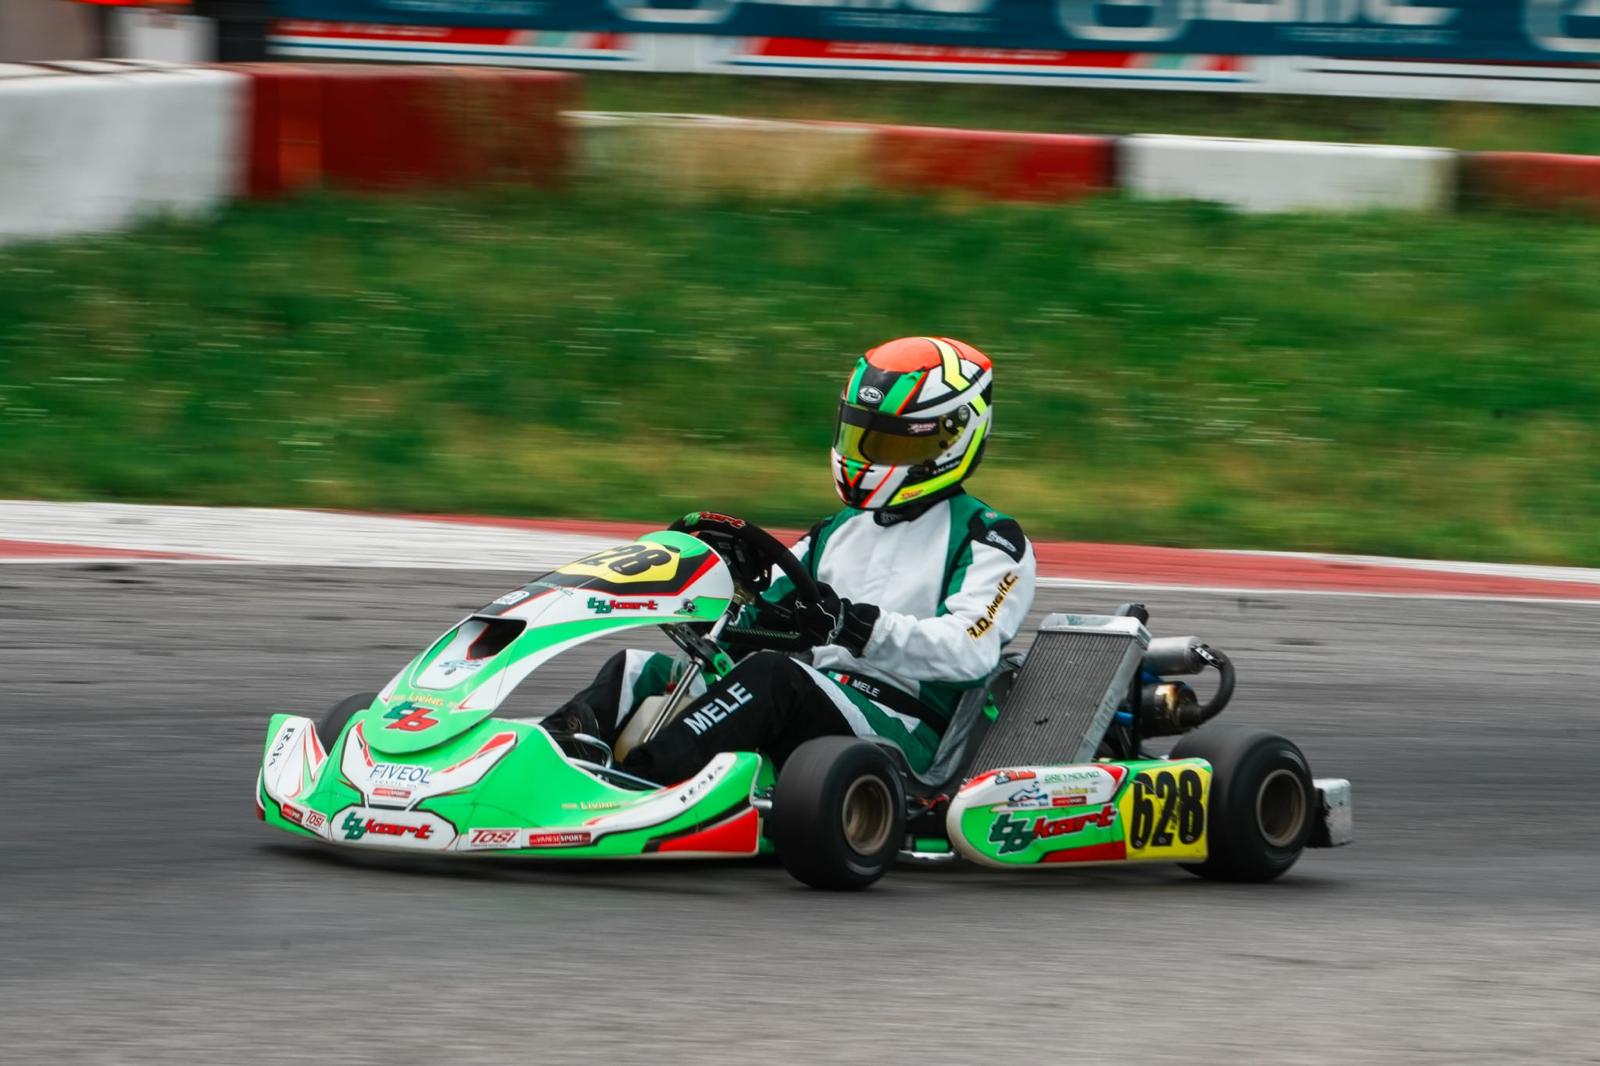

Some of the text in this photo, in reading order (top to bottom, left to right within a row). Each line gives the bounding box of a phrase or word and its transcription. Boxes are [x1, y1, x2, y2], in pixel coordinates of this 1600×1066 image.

[851, 679, 881, 698] MELE
[683, 681, 754, 736] MELE
[369, 764, 431, 785] FIVEOL
[305, 809, 327, 827] TOSI
[1129, 769, 1204, 850] 628
[471, 829, 520, 844] TOSI
